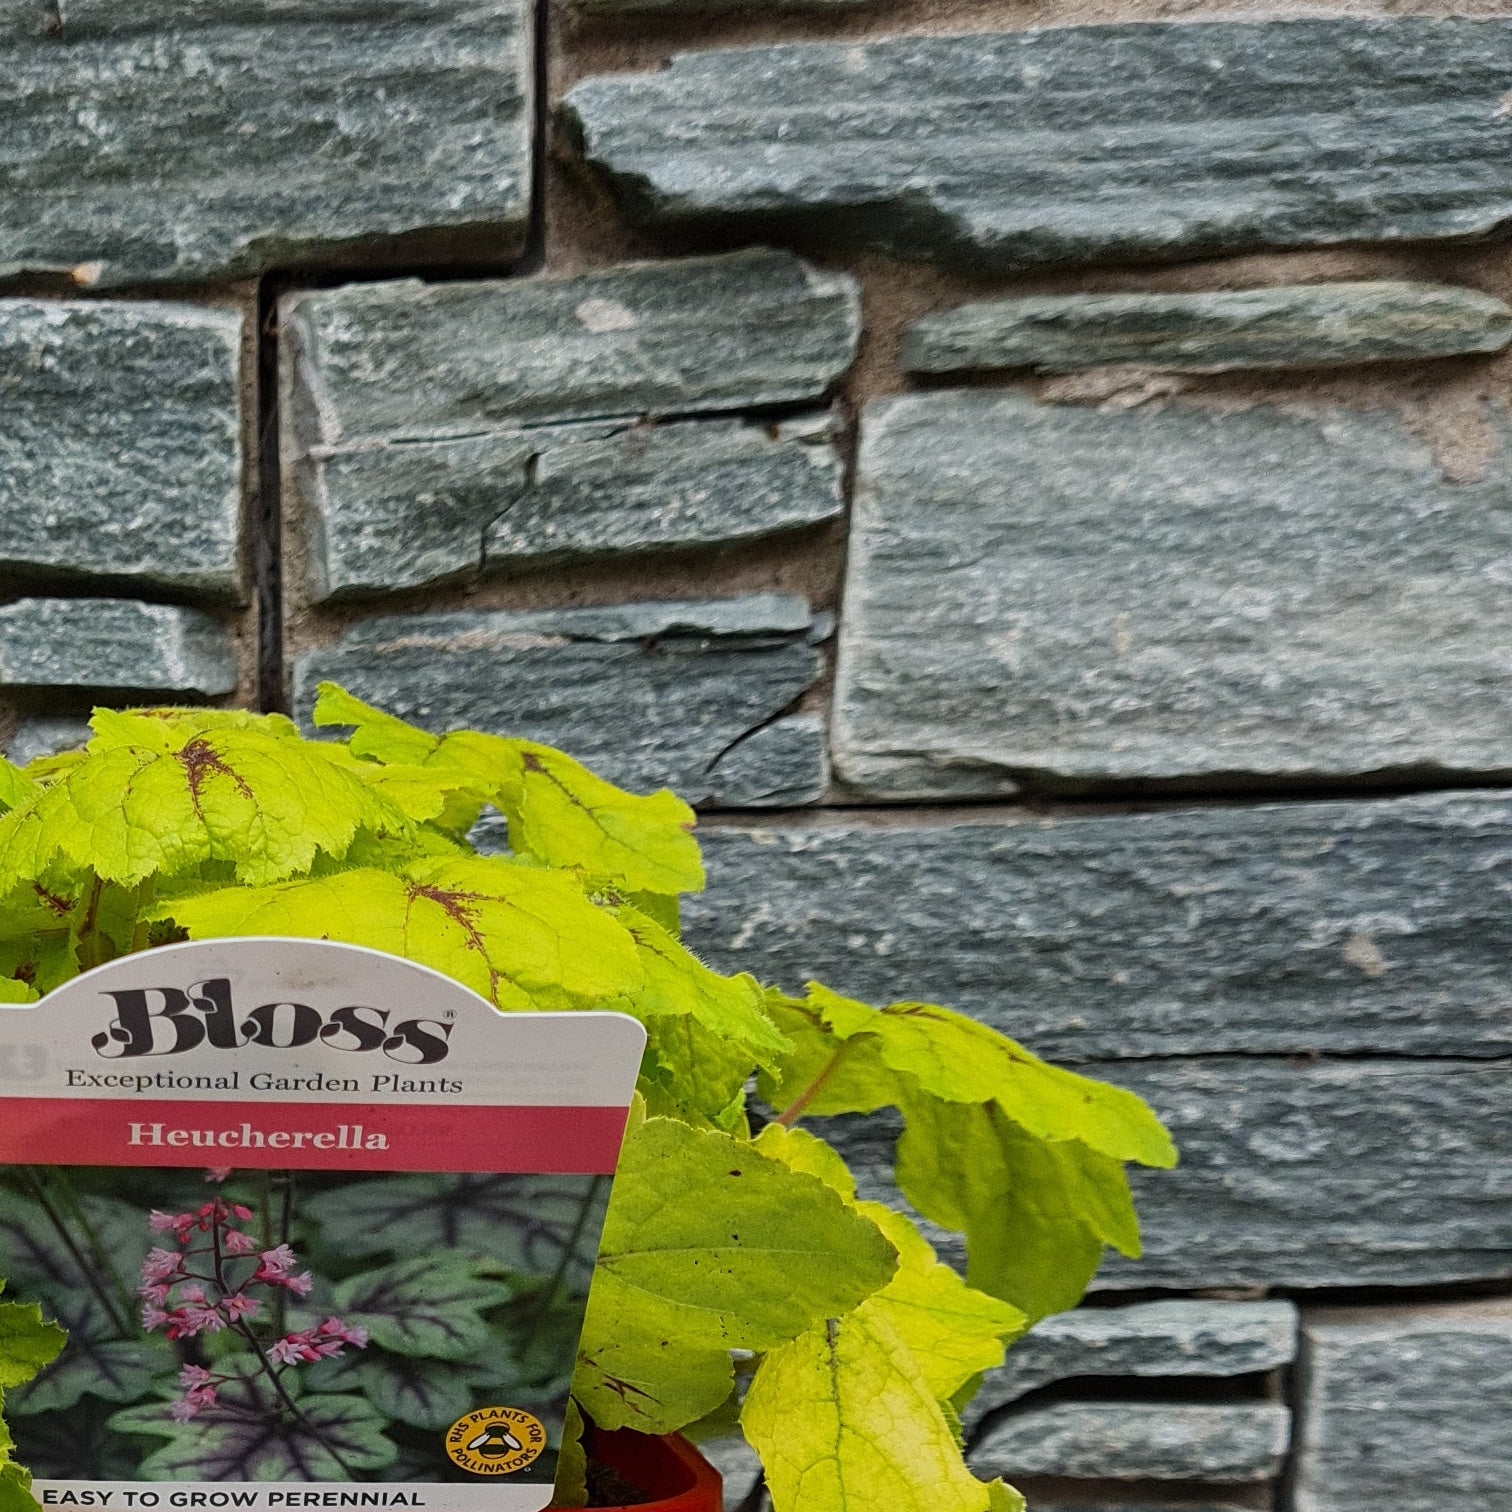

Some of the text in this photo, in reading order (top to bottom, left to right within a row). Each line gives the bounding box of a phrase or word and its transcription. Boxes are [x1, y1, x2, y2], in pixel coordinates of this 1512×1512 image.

[66, 1068, 240, 1094] Exceptional
[250, 1072, 361, 1093] Garden
[371, 1073, 464, 1095] Plants
[127, 1121, 390, 1151] Heucherella
[449, 1409, 543, 1444] RHS PLANTS FOR
[451, 1447, 538, 1473] POLLINATORS
[42, 1489, 426, 1508] EASY TO GROW PERENNIAL
